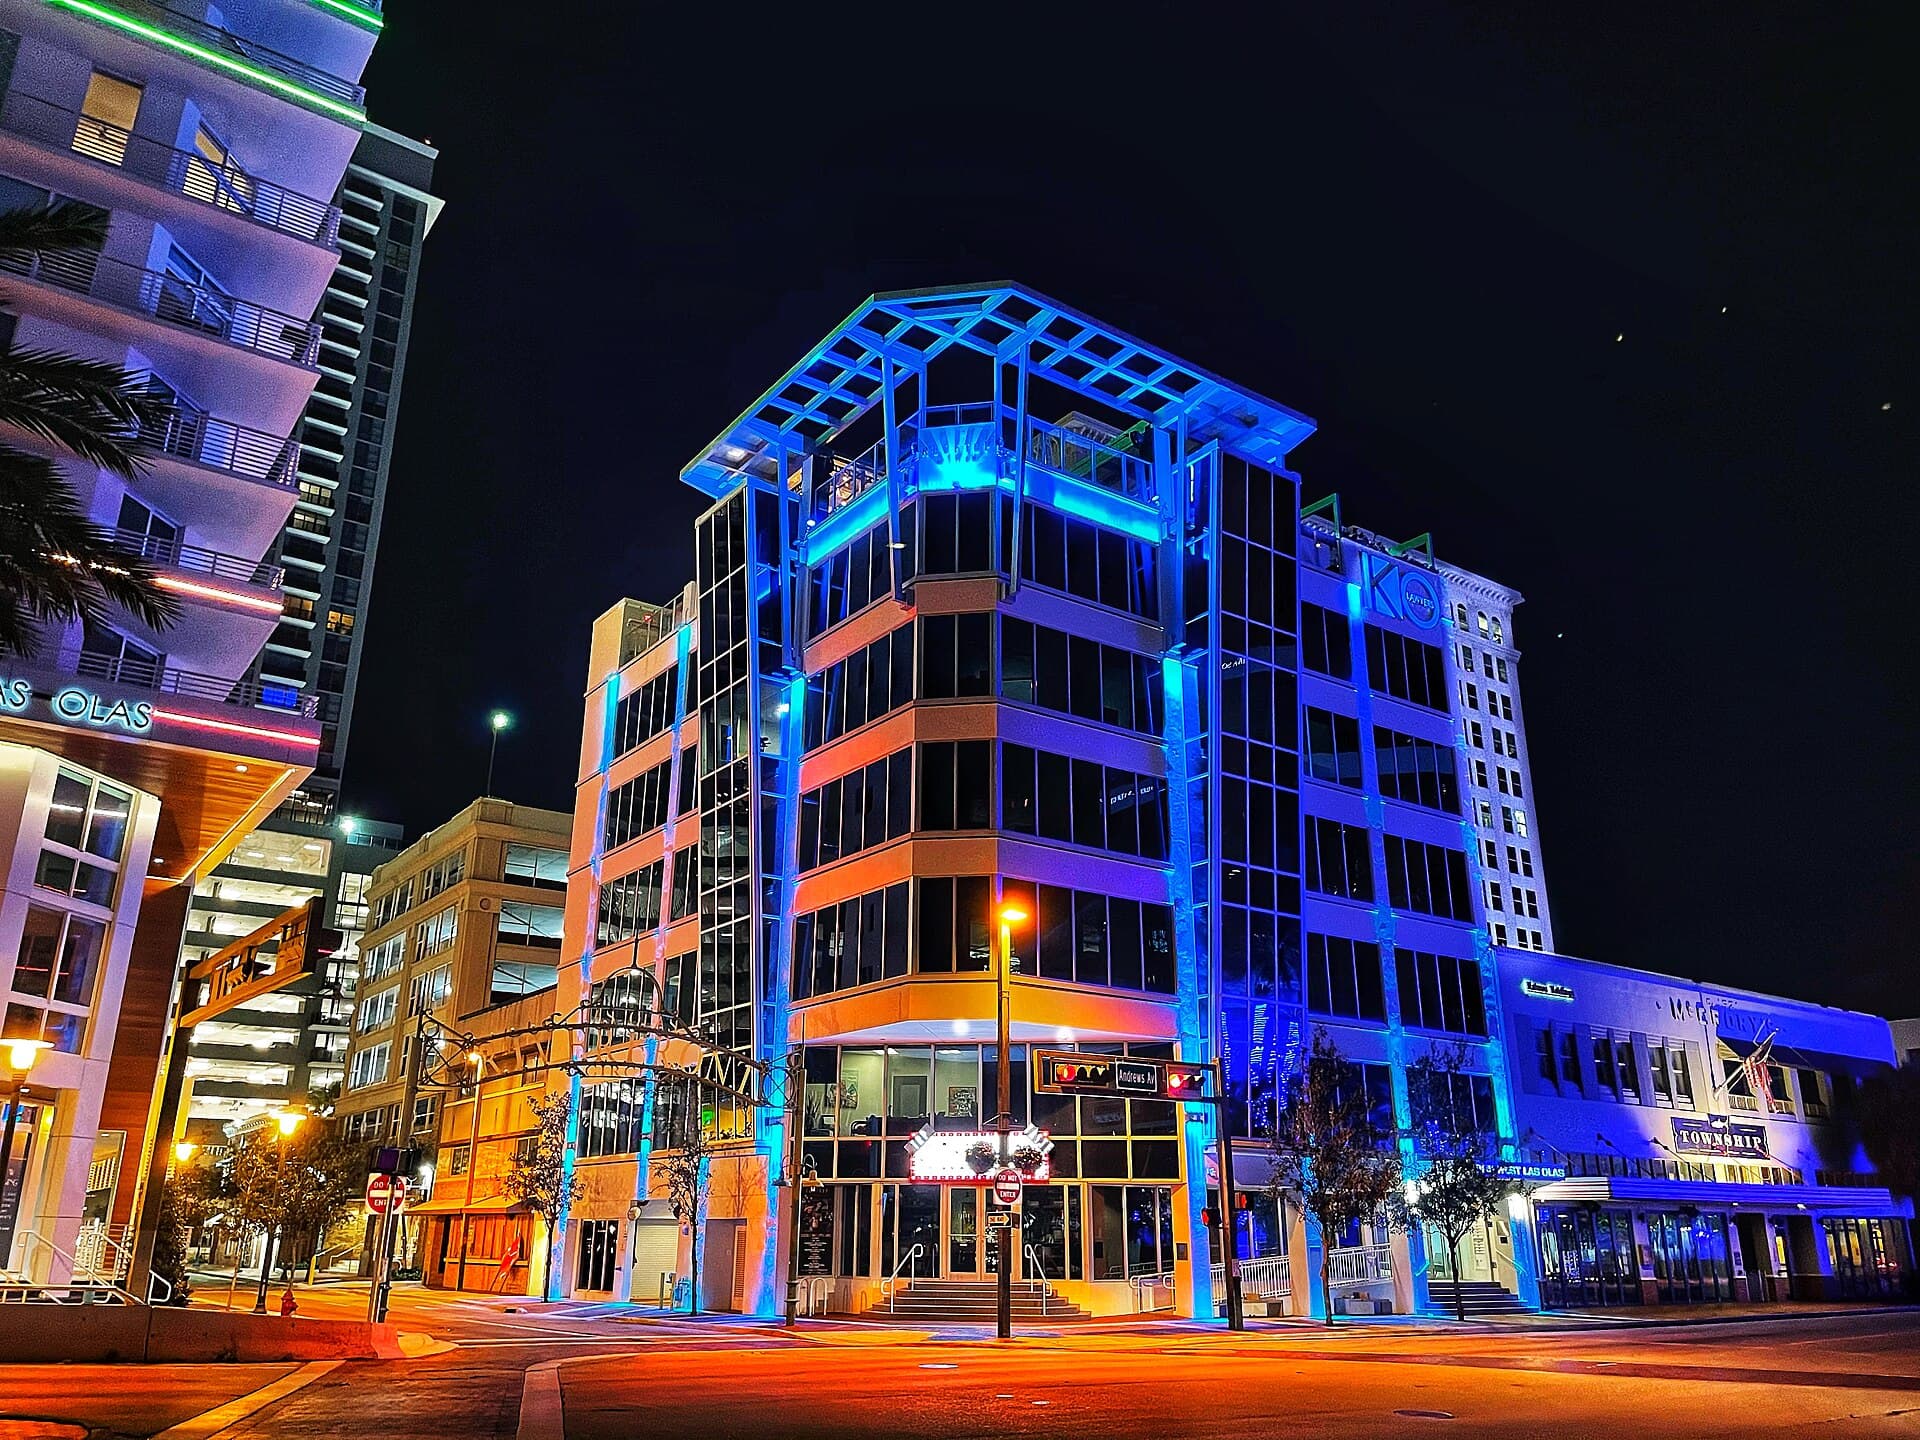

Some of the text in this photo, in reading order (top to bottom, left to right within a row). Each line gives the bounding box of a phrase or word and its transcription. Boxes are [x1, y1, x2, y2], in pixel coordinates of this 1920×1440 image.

[59, 690, 150, 728] OLAS
[1118, 1069, 1145, 1084] Andrews
[1680, 1130, 1762, 1149] TOWNSHIP
[1523, 1166, 1540, 1176] LAS
[1541, 1167, 1566, 1177] OLAS
[373, 1181, 384, 1189] DO
[1000, 1190, 1016, 1198] ENTER
